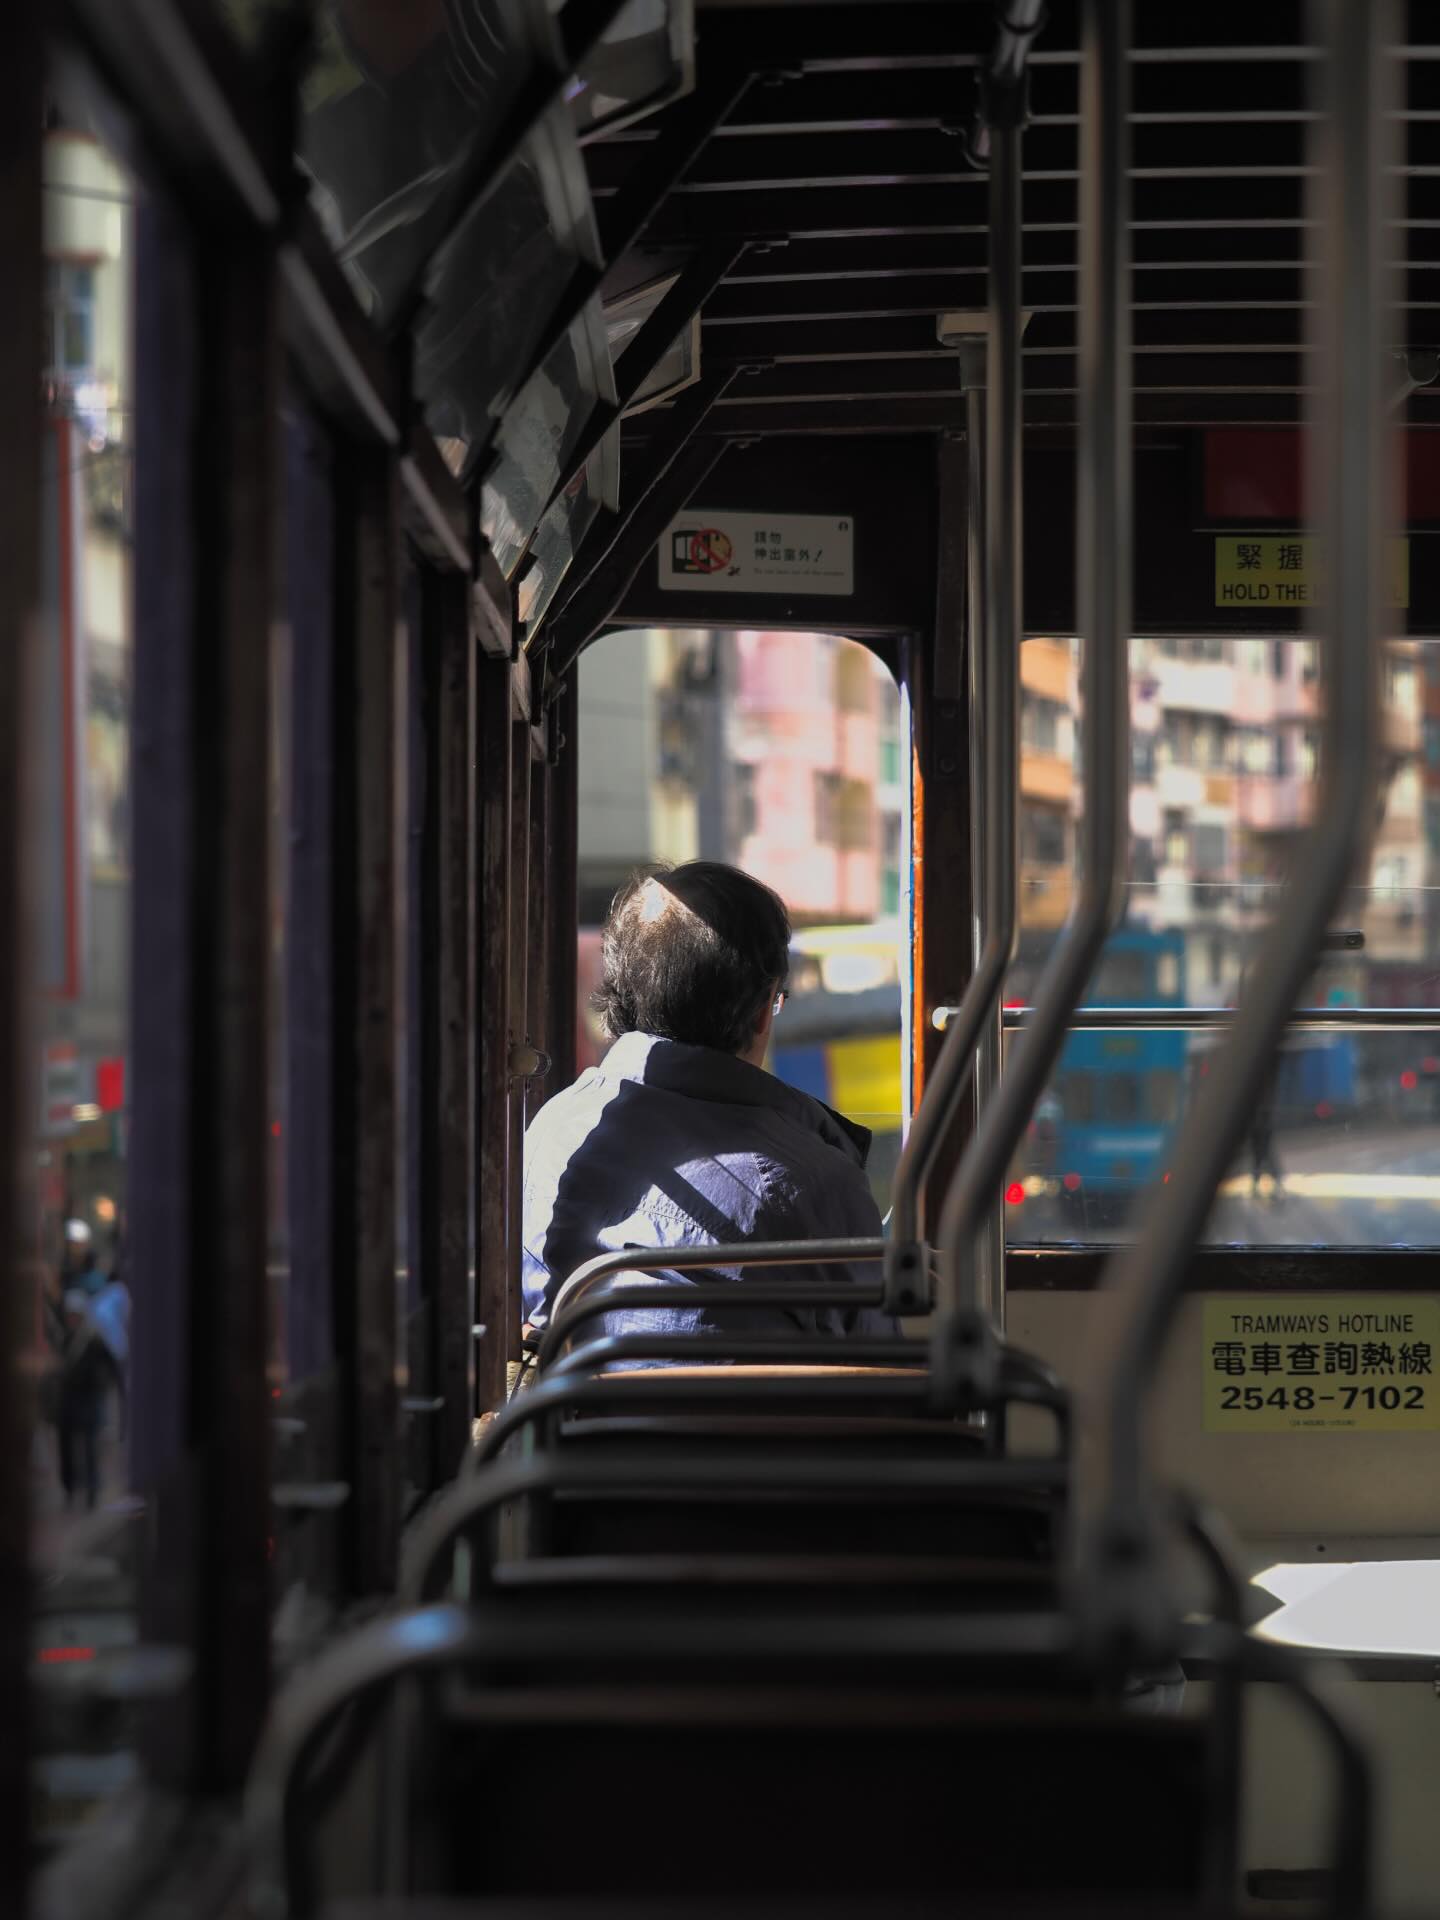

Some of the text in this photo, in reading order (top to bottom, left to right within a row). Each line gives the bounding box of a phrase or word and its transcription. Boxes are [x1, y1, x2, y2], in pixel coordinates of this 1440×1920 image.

[1222, 583, 1270, 601] HOLD
[1275, 583, 1308, 601] THE
[1231, 1314, 1414, 1333] TRAMWAYS HOTLINE
[1211, 1341, 1433, 1376] 電車查詢熱線
[1220, 1385, 1425, 1411] 2548-7102
